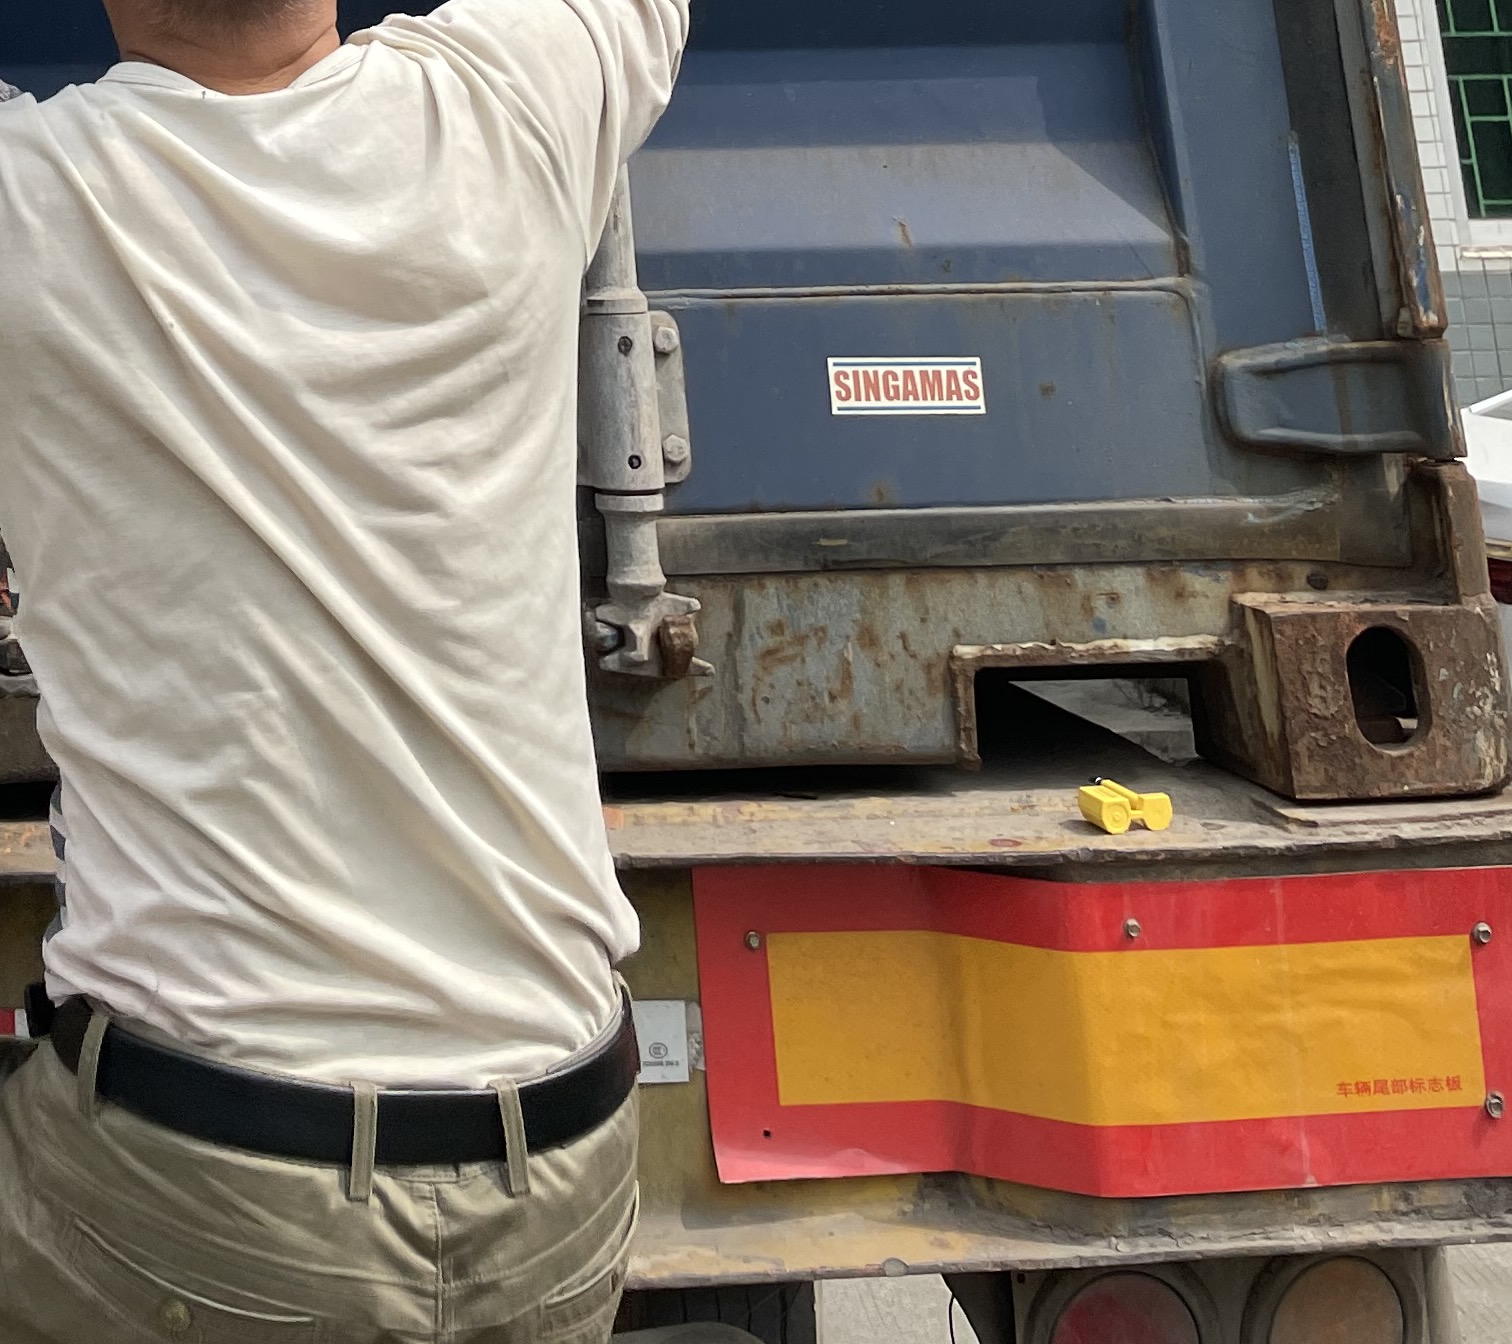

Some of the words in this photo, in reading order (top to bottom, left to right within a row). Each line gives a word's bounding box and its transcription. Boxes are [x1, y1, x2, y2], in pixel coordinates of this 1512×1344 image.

[833, 369, 981, 402] SINGAMAS
[1336, 1075, 1463, 1098] 车辆尾部标志板
